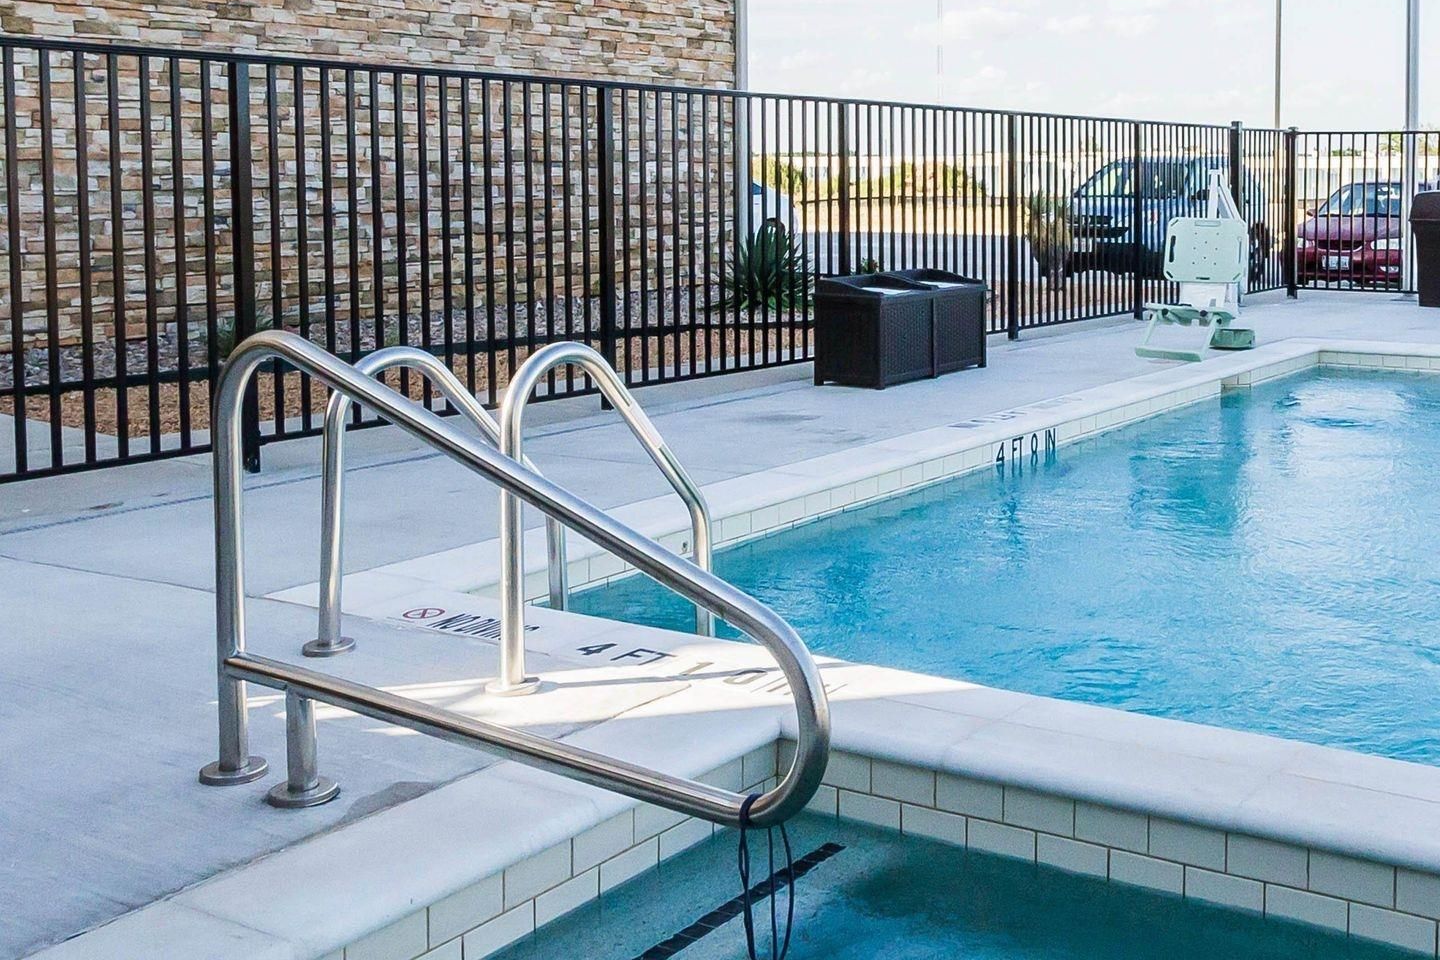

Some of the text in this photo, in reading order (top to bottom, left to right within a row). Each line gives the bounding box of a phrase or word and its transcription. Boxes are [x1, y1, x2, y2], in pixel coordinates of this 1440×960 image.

[996, 441, 1005, 463] 4
[1011, 436, 1024, 461] FT
[1045, 427, 1056, 450] IN
[426, 613, 481, 630] NO
[576, 642, 617, 656] 4
[609, 648, 677, 666] FT
